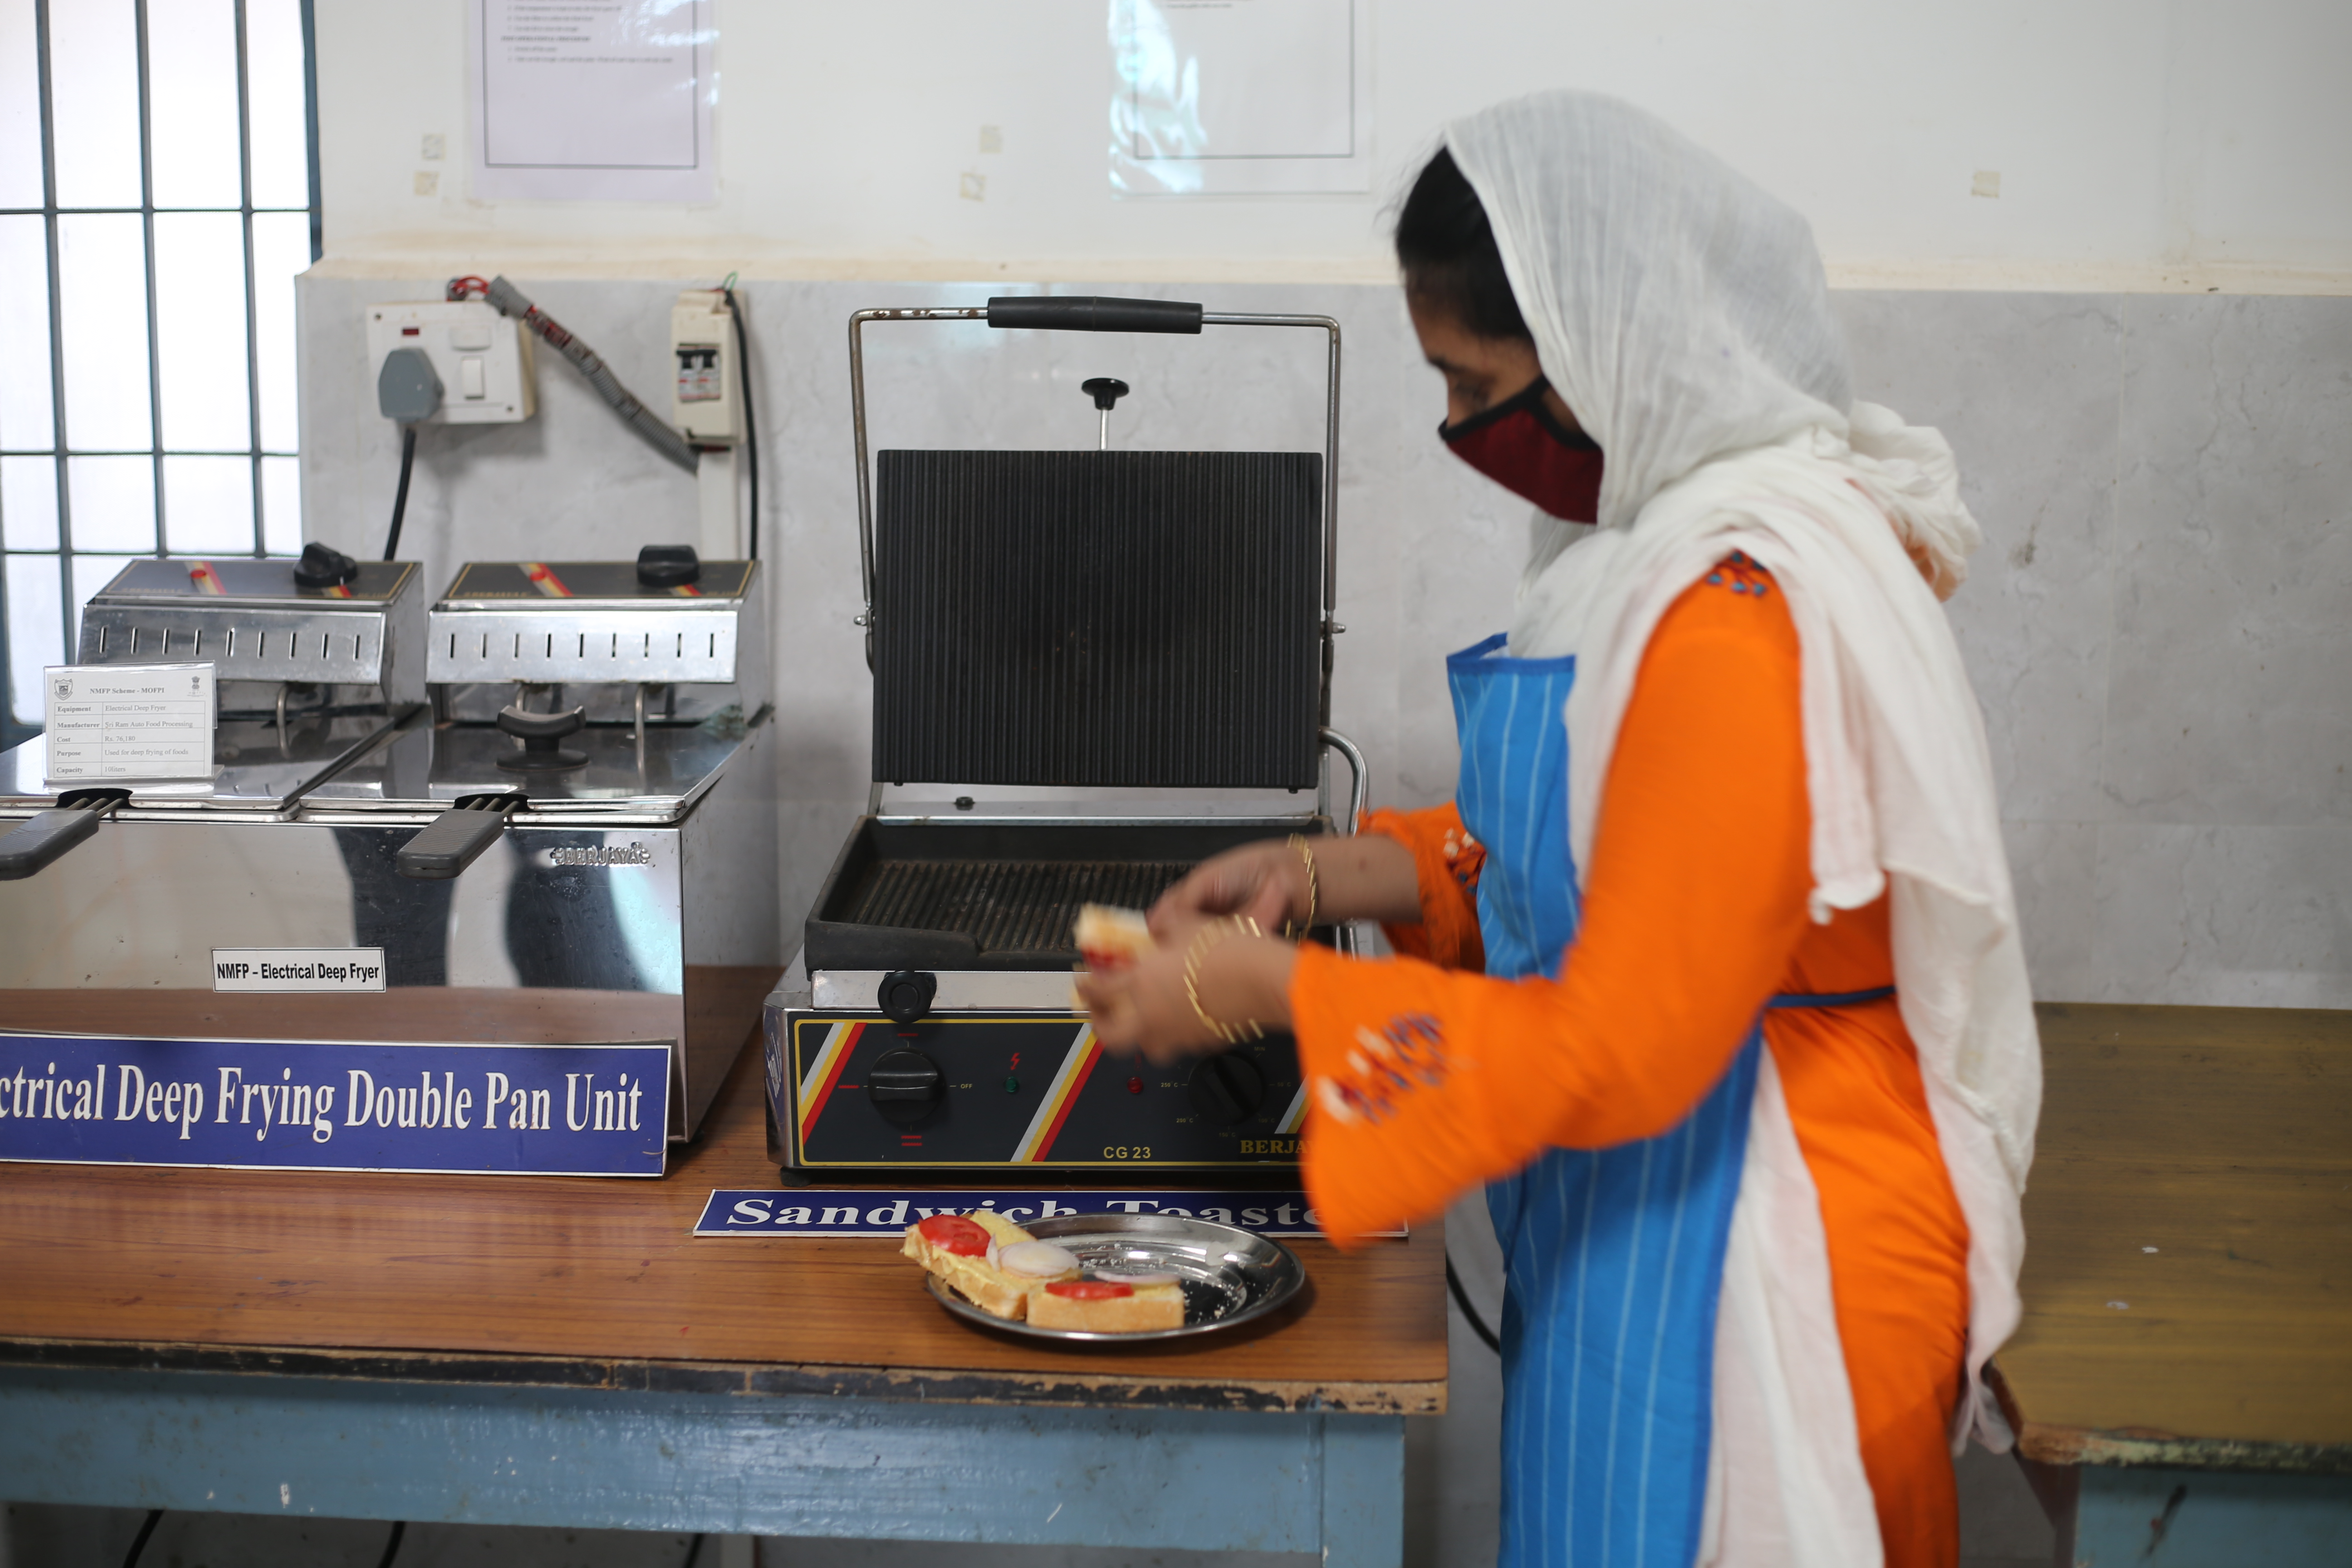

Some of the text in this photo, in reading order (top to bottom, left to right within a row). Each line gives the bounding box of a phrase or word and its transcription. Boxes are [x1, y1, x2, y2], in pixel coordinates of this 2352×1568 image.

[563, 847, 640, 866] BERJAYA
[217, 963, 249, 979] NMFP
[261, 963, 315, 979] Electrical
[318, 963, 347, 982] Deep
[350, 963, 379, 982] Fryer
[114, 1064, 204, 1140] Deep
[215, 1067, 335, 1143] Frying
[343, 1069, 472, 1130] Double
[483, 1072, 550, 1131] Pan
[566, 1073, 643, 1132] Unit
[1103, 1147, 1151, 1159] CG 23
[1240, 1140, 1313, 1154] BERJA
